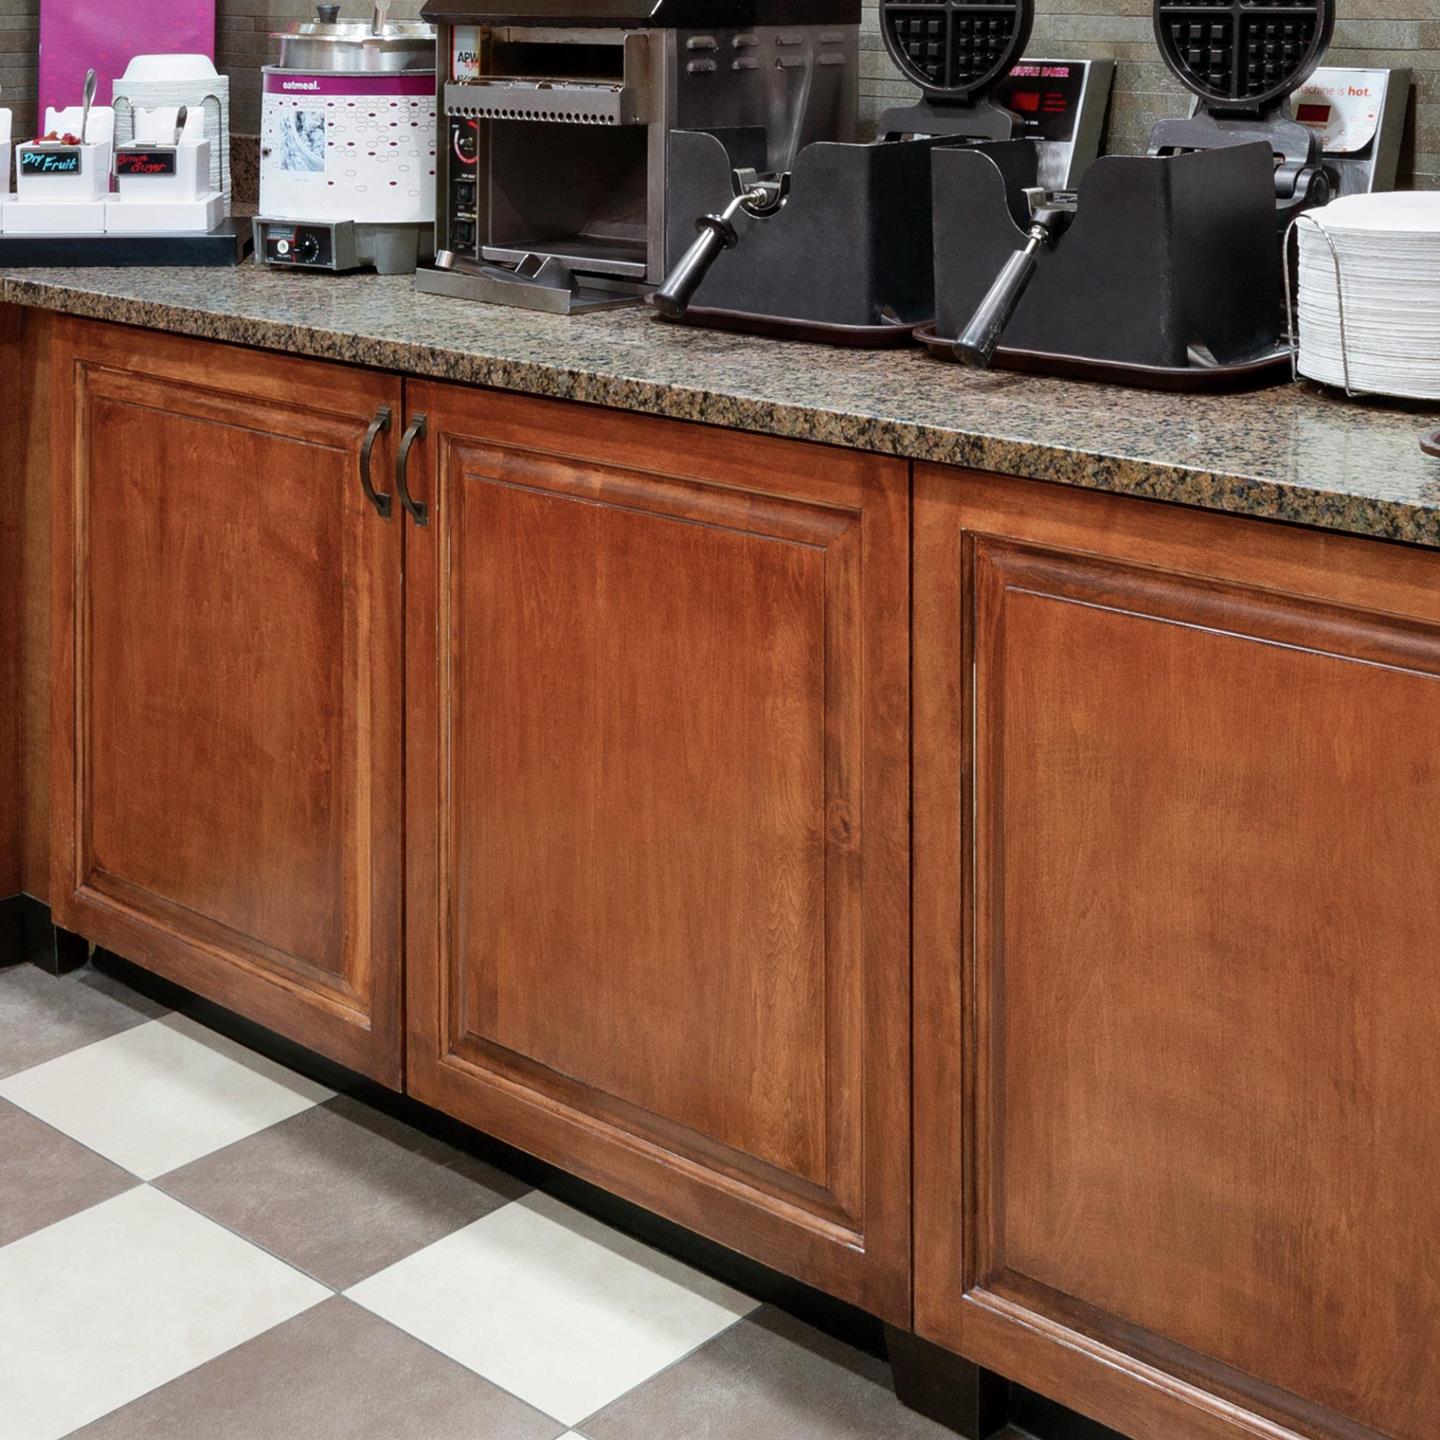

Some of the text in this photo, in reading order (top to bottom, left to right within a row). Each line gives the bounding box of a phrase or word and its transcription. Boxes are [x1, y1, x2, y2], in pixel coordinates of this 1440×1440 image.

[282, 80, 320, 91] oatmeal.
[1347, 85, 1372, 97] hot.
[22, 152, 79, 172] Dry Fruit
